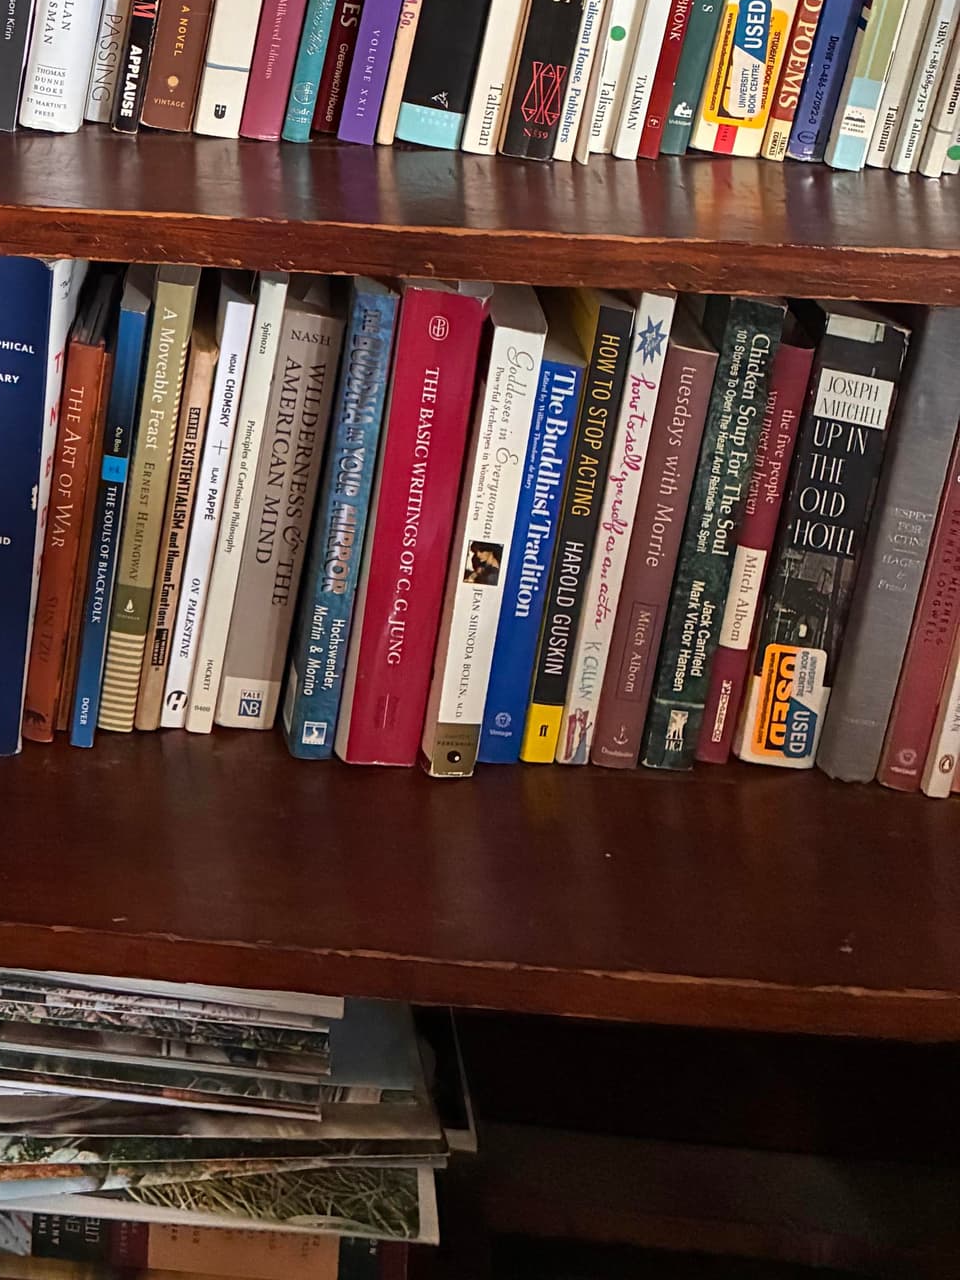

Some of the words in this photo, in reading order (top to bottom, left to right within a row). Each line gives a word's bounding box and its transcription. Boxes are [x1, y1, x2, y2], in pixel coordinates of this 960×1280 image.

[173, 18, 190, 56] NOVEL
[744, 0, 766, 49] USED
[92, 13, 123, 102] PASSING
[120, 45, 143, 118] APPLAUSE
[291, 330, 331, 346] NASH
[598, 334, 621, 374] HOW
[549, 371, 577, 414] The
[591, 381, 612, 400] TO
[583, 407, 607, 450] STOP
[532, 418, 569, 518] Buddhist
[571, 454, 599, 516] ACTING
[515, 521, 550, 617] Tradition
[557, 541, 584, 608] HAROLD
[544, 615, 571, 675] GUSKIN
